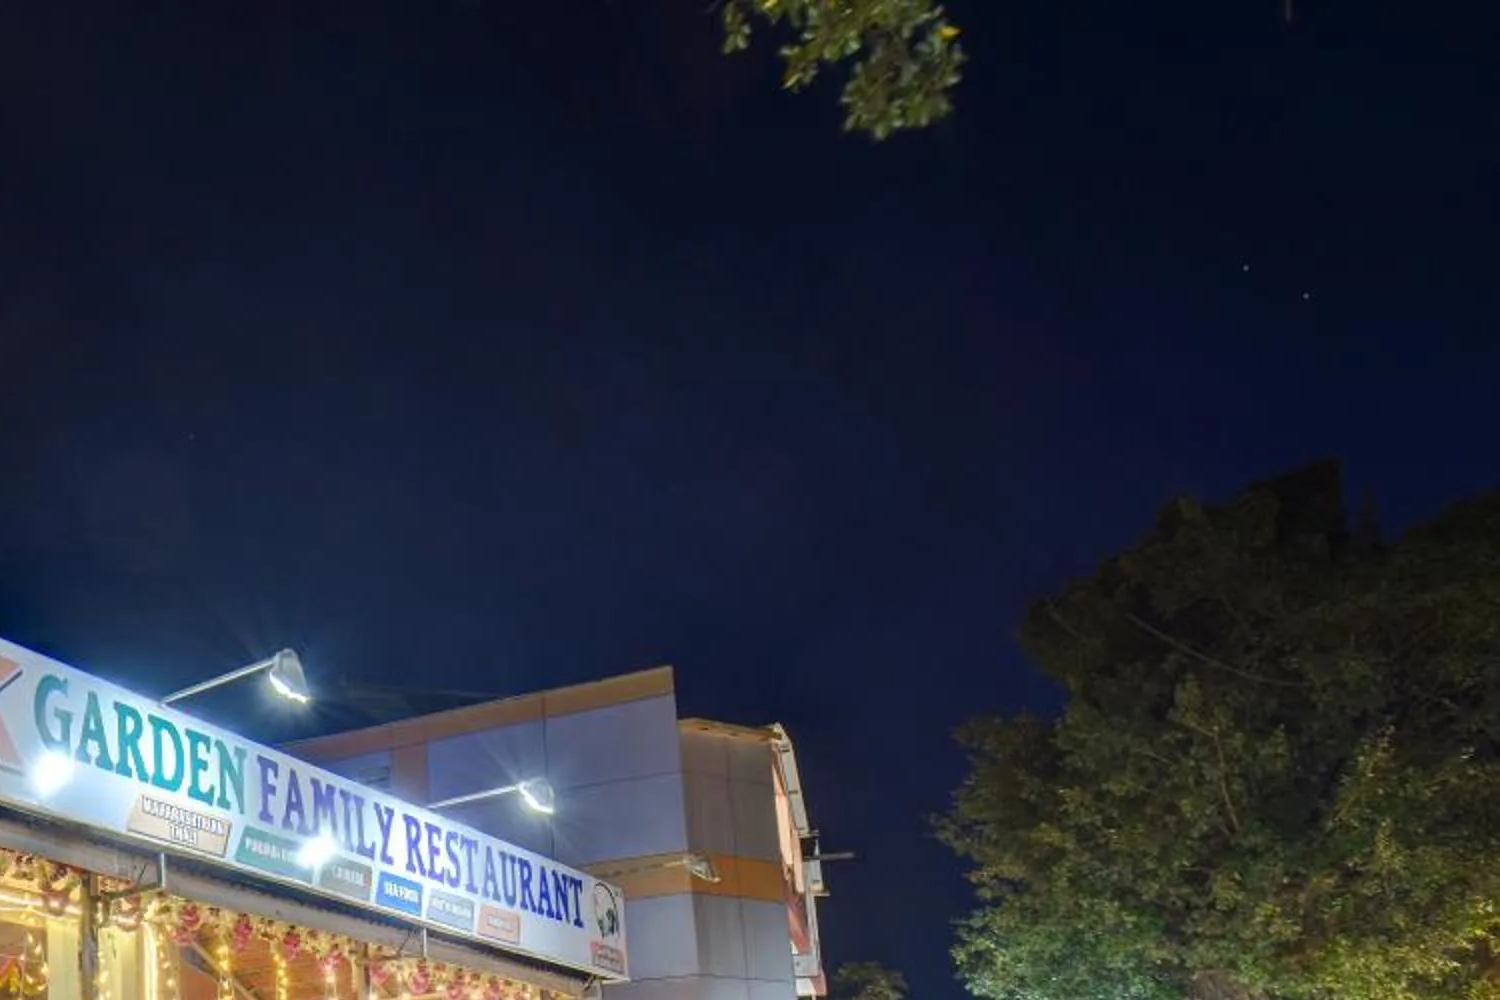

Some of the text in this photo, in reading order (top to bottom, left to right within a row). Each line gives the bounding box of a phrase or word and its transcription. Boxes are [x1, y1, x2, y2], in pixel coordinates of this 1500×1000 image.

[33, 673, 247, 815] GARDEN
[257, 754, 398, 865] FAMILY
[402, 813, 584, 928] RESTAURANT
